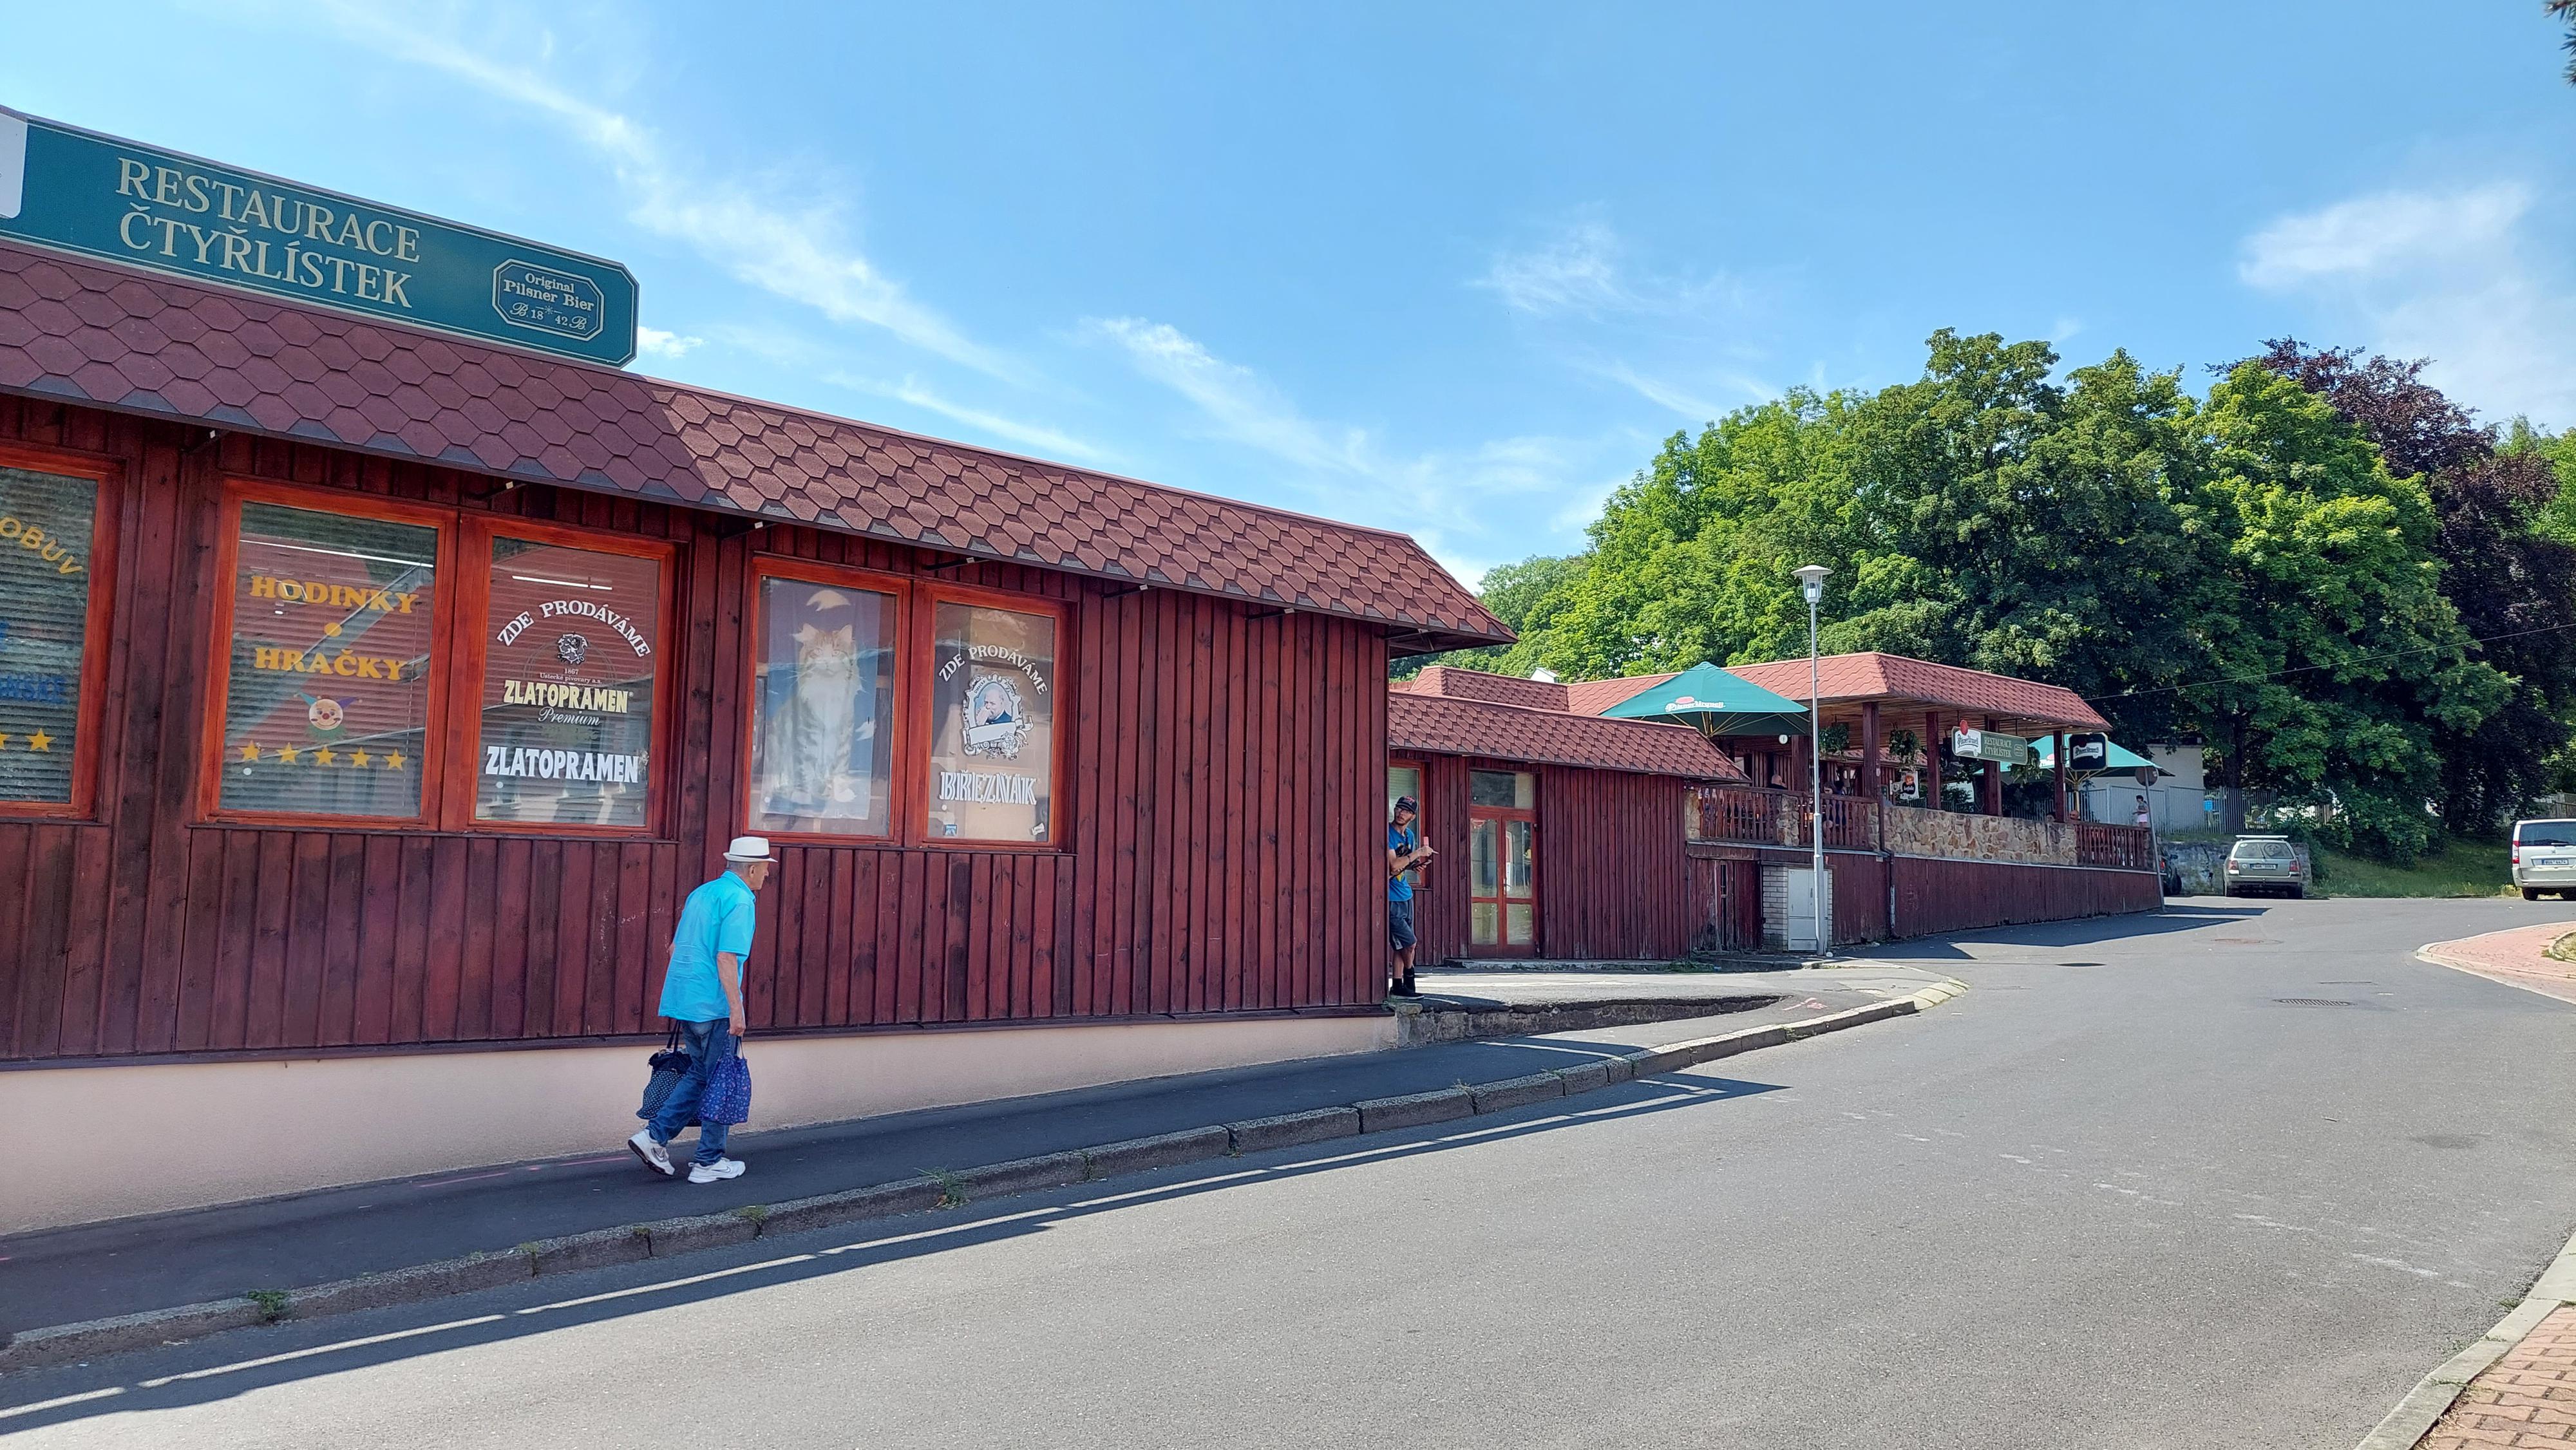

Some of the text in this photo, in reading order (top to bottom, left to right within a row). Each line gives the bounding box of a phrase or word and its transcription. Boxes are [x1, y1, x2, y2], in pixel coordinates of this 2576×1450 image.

[115, 157, 421, 263] RESTAURACE
[120, 201, 413, 308] ČTYŘLÍSTEK
[503, 279, 594, 311] Pilsner Bier
[525, 273, 575, 293] Original
[531, 309, 544, 321] 18
[554, 315, 569, 326] 42
[0, 517, 83, 574] OBUV
[249, 576, 419, 614] HODINKY
[497, 599, 651, 657] ZDE PRODÁVÁME
[254, 647, 408, 681] HRAČKY
[564, 675, 591, 684] pivovary
[938, 645, 1048, 695] ZDE PRODÁVÁME
[538, 706, 601, 726] Premium
[1984, 737, 2012, 748] RESTAURACE
[485, 745, 639, 784] ZLATOPRAMEN
